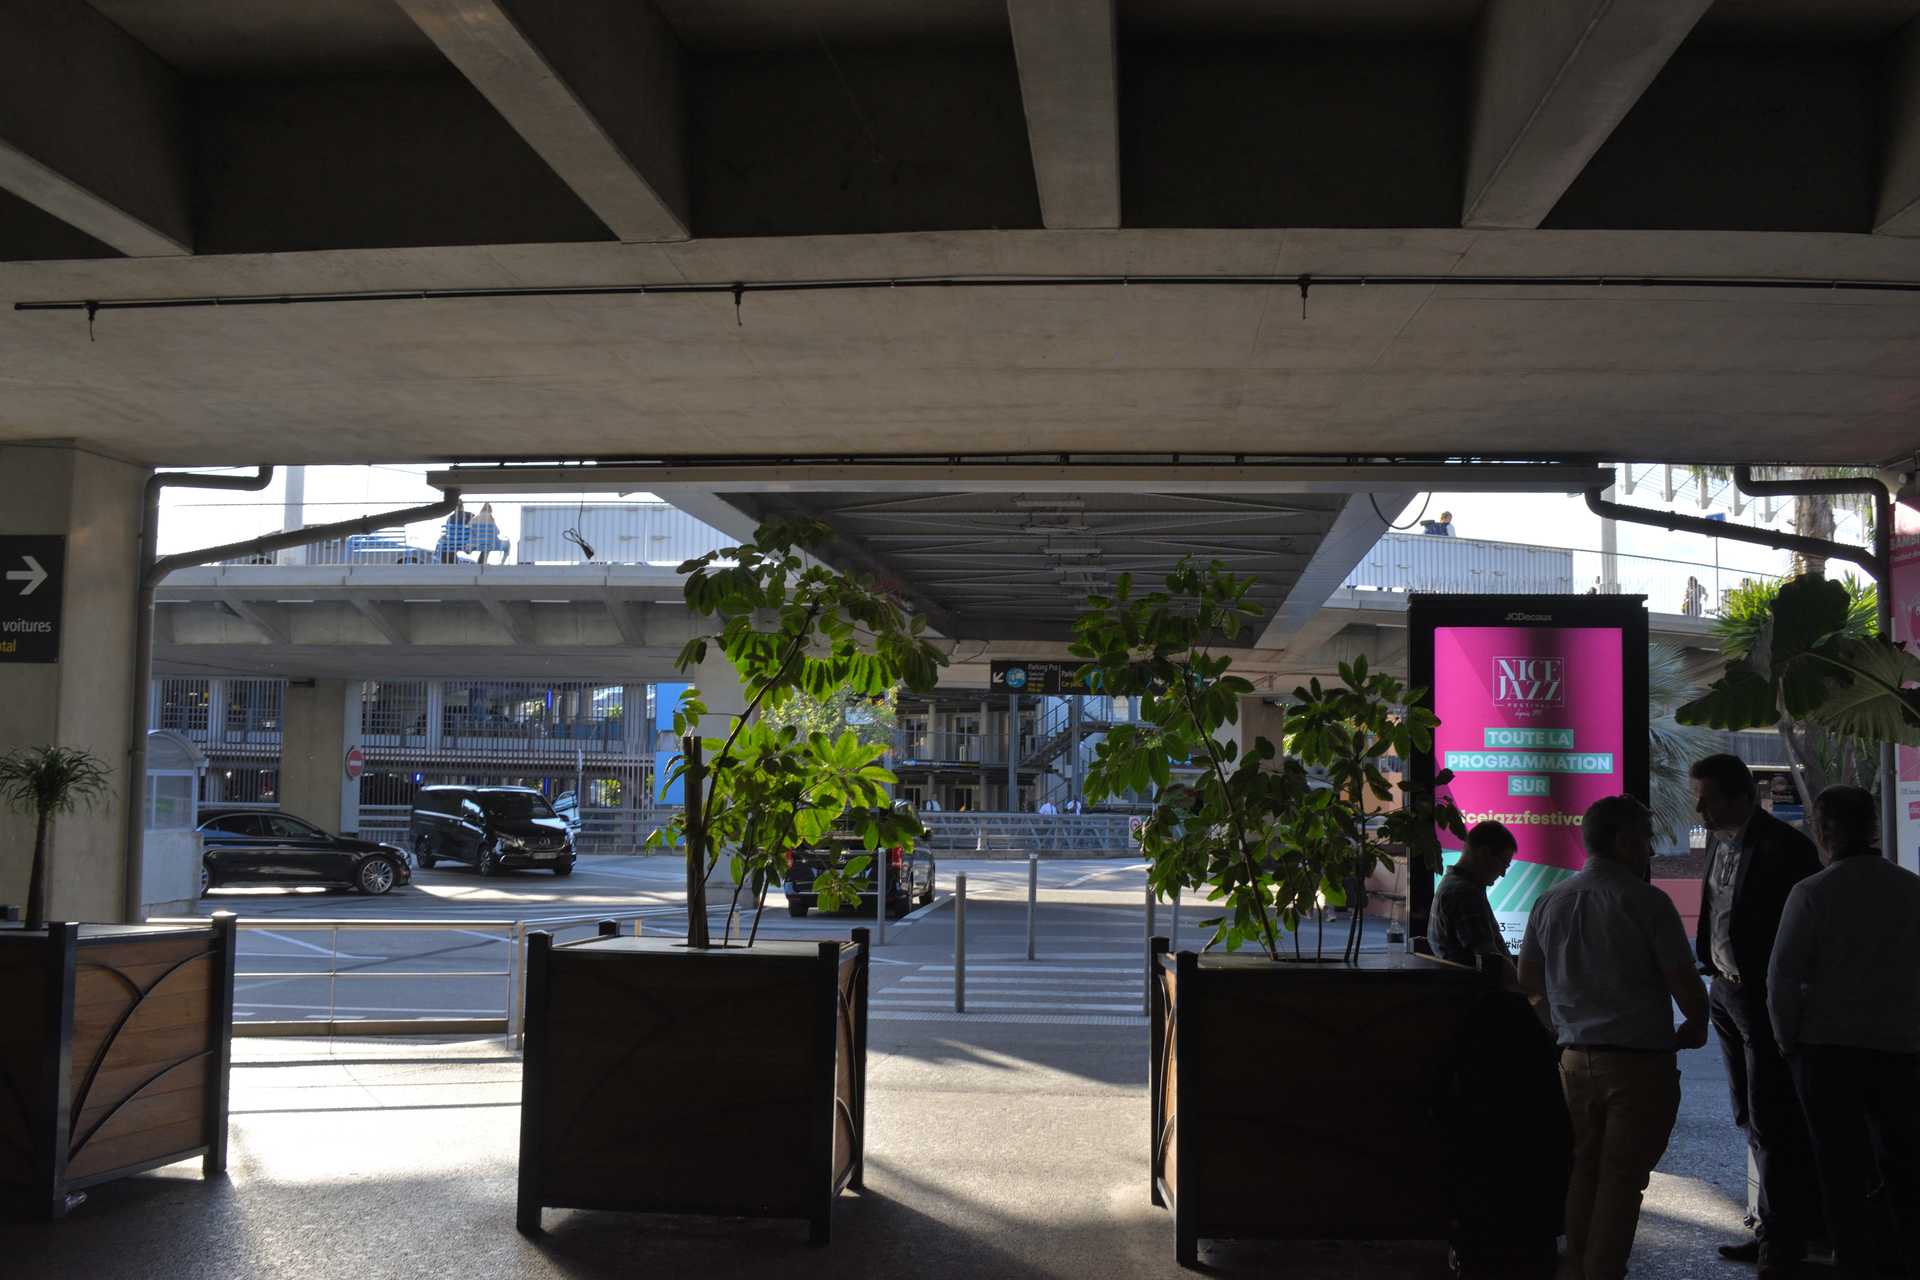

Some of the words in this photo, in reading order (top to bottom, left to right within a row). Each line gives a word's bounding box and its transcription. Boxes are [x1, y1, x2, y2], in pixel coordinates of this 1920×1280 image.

[1504, 612, 1552, 621] JCDecaux
[2, 617, 52, 633] voitures
[1497, 659, 1561, 681] NICE
[1495, 675, 1561, 701] JAZZ
[1487, 731, 1545, 745] TOUTE
[1551, 732, 1569, 746] LA
[1447, 754, 1610, 770] PROGRAMMATION
[1511, 779, 1547, 793] SUR
